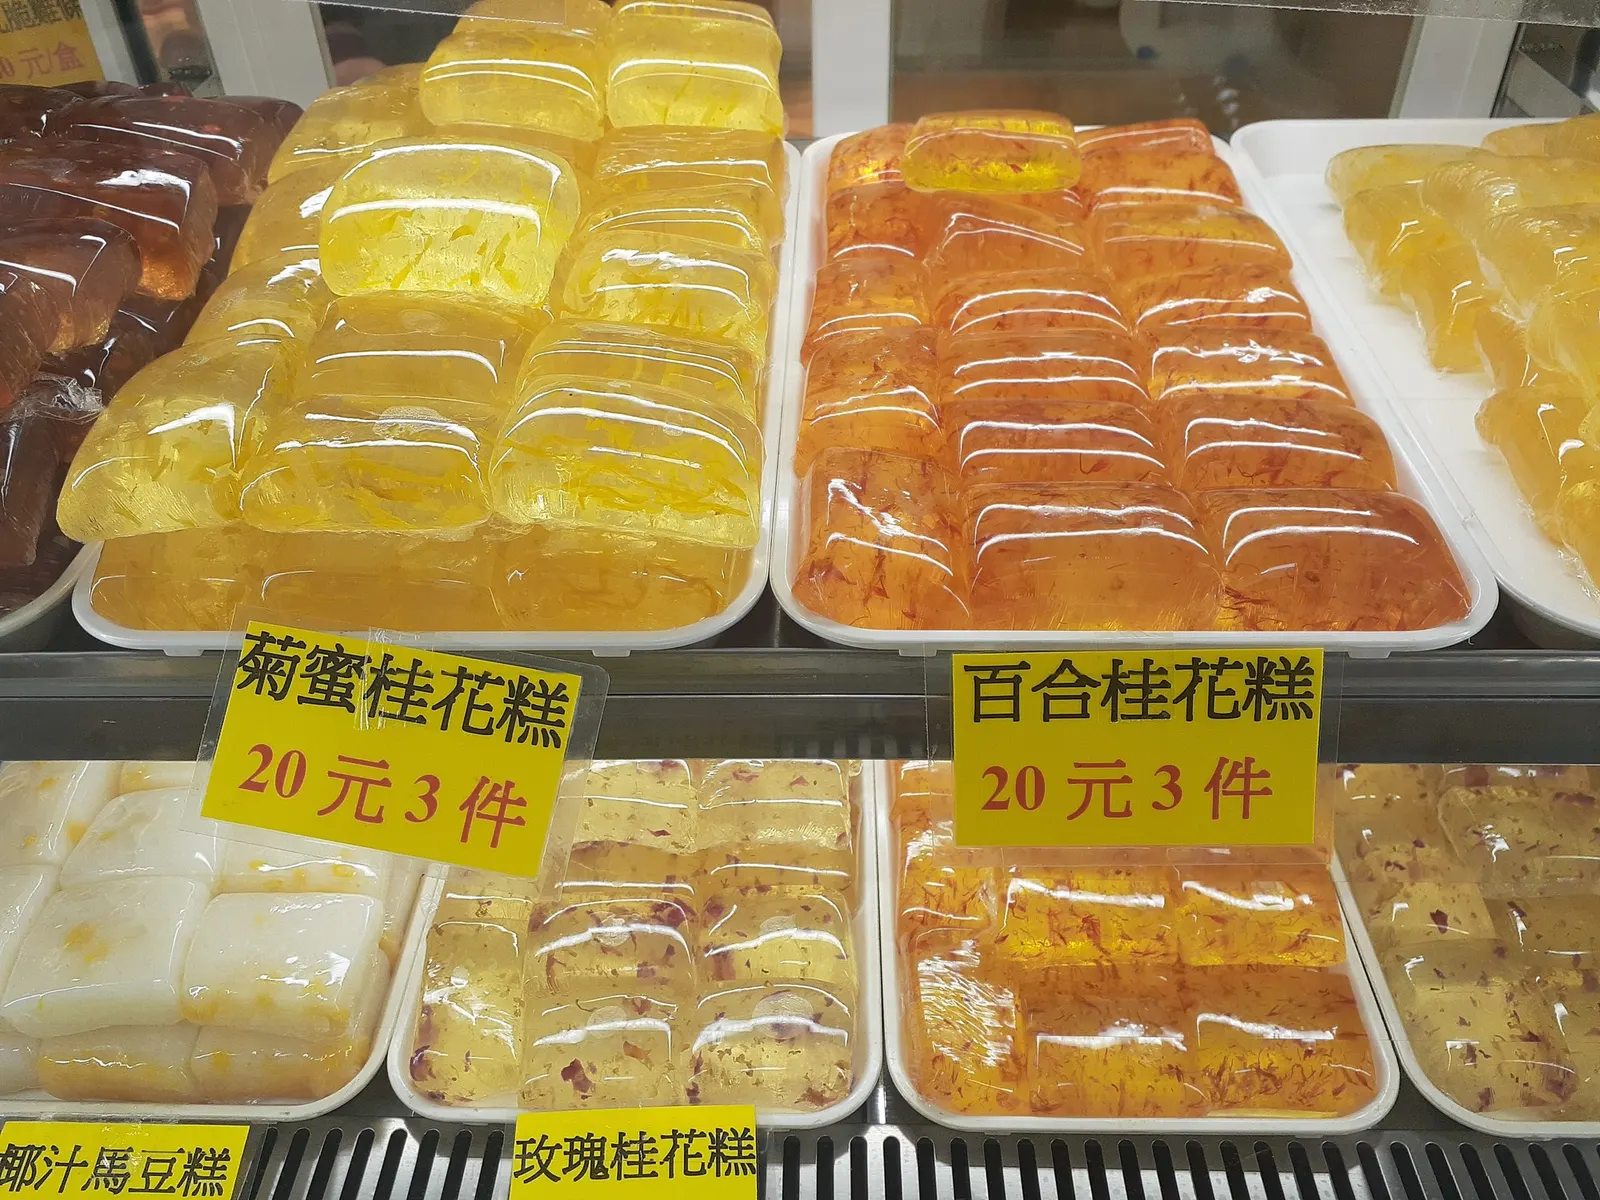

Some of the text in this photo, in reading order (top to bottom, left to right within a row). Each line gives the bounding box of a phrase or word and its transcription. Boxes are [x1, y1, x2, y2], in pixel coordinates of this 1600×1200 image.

[236, 631, 570, 749] 菊蜜桂花糕
[963, 656, 1315, 723] 百合桂花糕
[238, 743, 527, 849] 20 元 3 件
[981, 756, 1274, 821] 20 元 3 件
[0, 1143, 231, 1197] 椰汁馬豆糕
[513, 1127, 757, 1184] 玫瑰桂花糕
